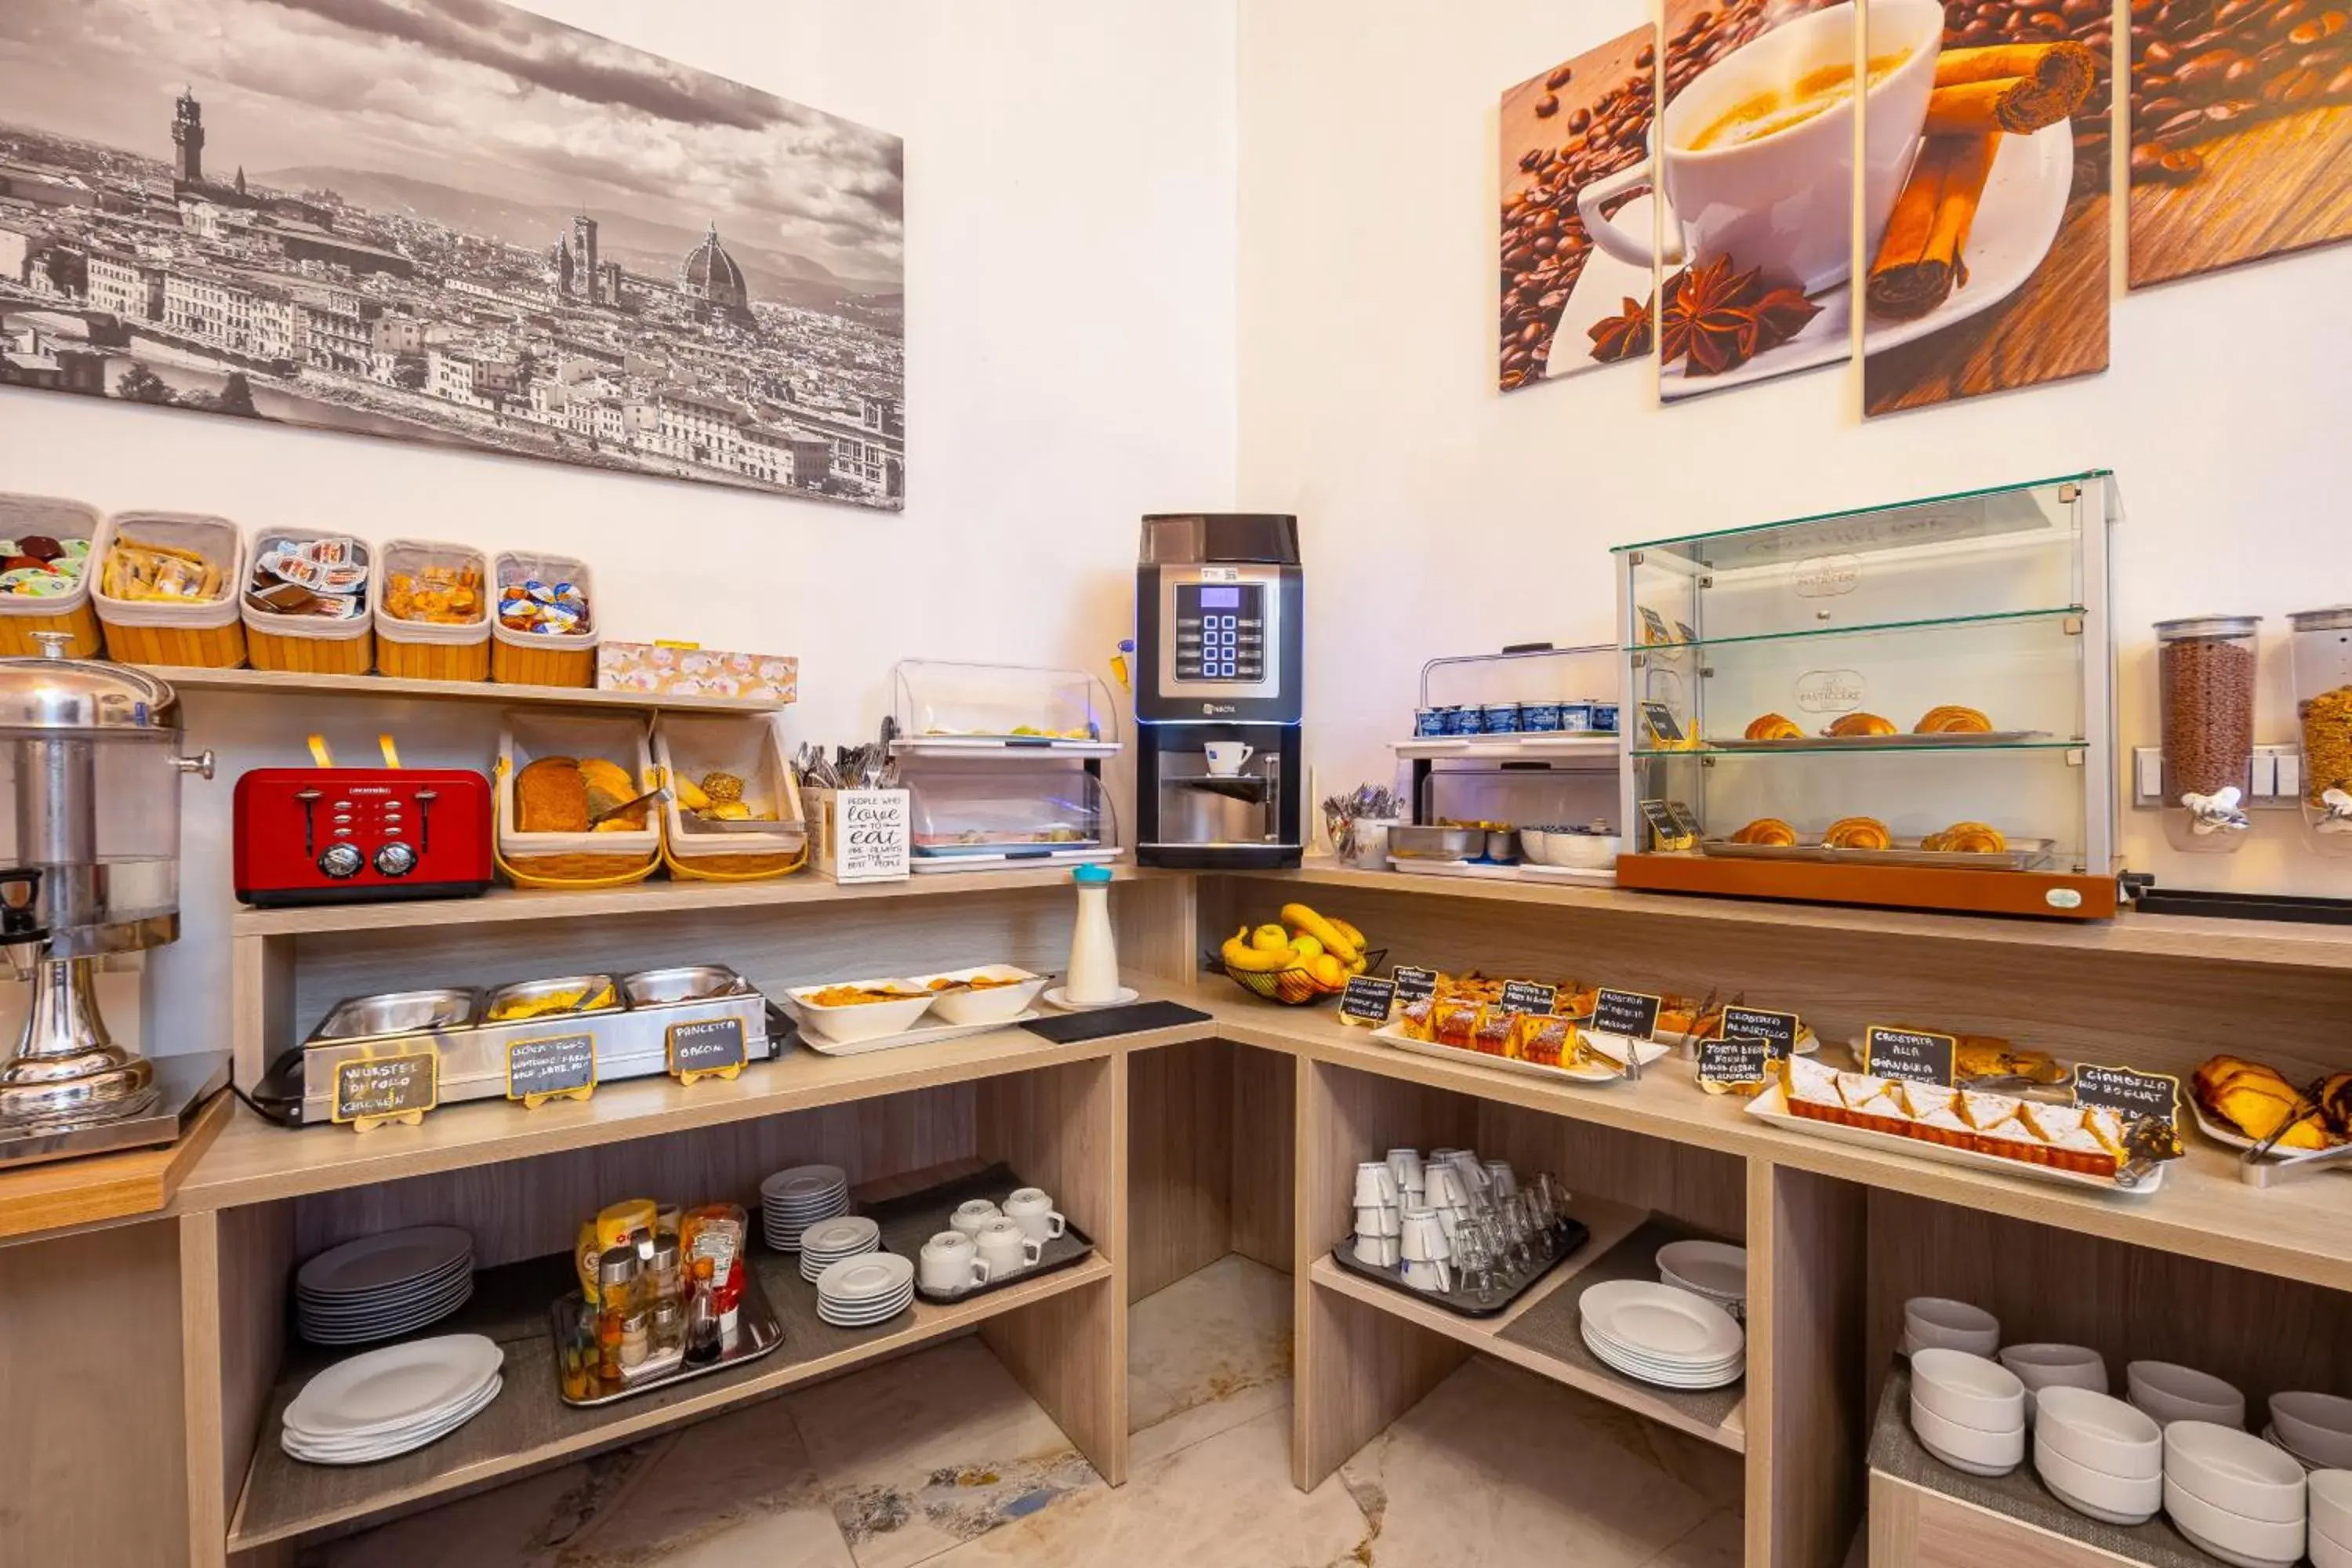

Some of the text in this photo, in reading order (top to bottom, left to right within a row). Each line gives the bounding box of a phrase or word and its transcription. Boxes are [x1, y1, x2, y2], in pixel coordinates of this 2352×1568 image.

[883, 797, 901, 805] WHO
[848, 805, 900, 822] love
[850, 829, 901, 846] eat
[874, 858, 900, 868] PEOPLE
[676, 1021, 735, 1036] PANCETTA
[1875, 1032, 1934, 1047] CROSTATA
[1893, 1045, 1920, 1057] ALLA
[346, 1064, 418, 1080] WURSTEL
